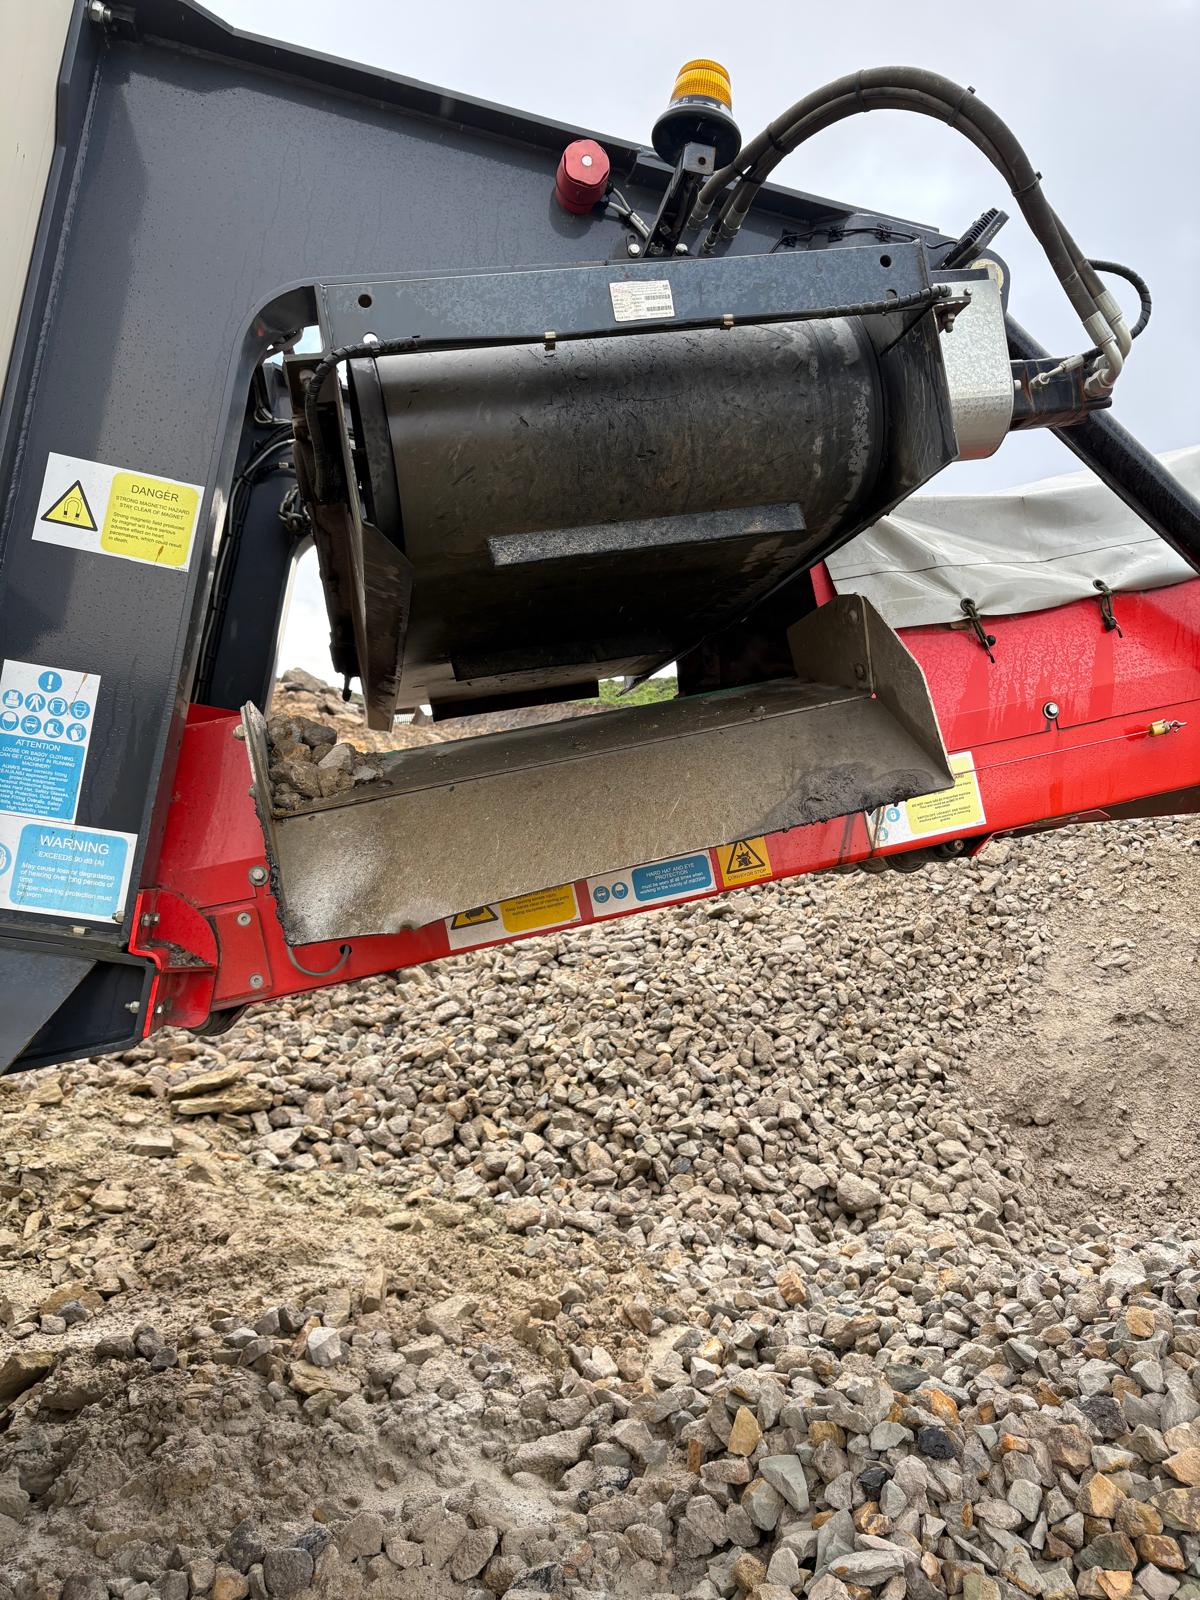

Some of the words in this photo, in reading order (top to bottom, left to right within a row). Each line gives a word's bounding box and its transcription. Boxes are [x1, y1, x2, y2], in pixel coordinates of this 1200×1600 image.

[130, 484, 179, 502] DANGER
[115, 495, 138, 504] STRONG
[139, 500, 167, 510] MAGNETIC
[168, 506, 190, 515] HAZARD
[133, 505, 151, 513] CLEAR
[160, 511, 183, 520] MAGNET
[15, 739, 60, 750] ATTENTION
[49, 753, 73, 761] CLOTHING
[38, 834, 110, 855] WARNING
[38, 851, 72, 861] EXCEEDS
[21, 862, 35, 870] May
[654, 868, 688, 881] PROTECTION
[727, 870, 753, 880] CONVEYOR
